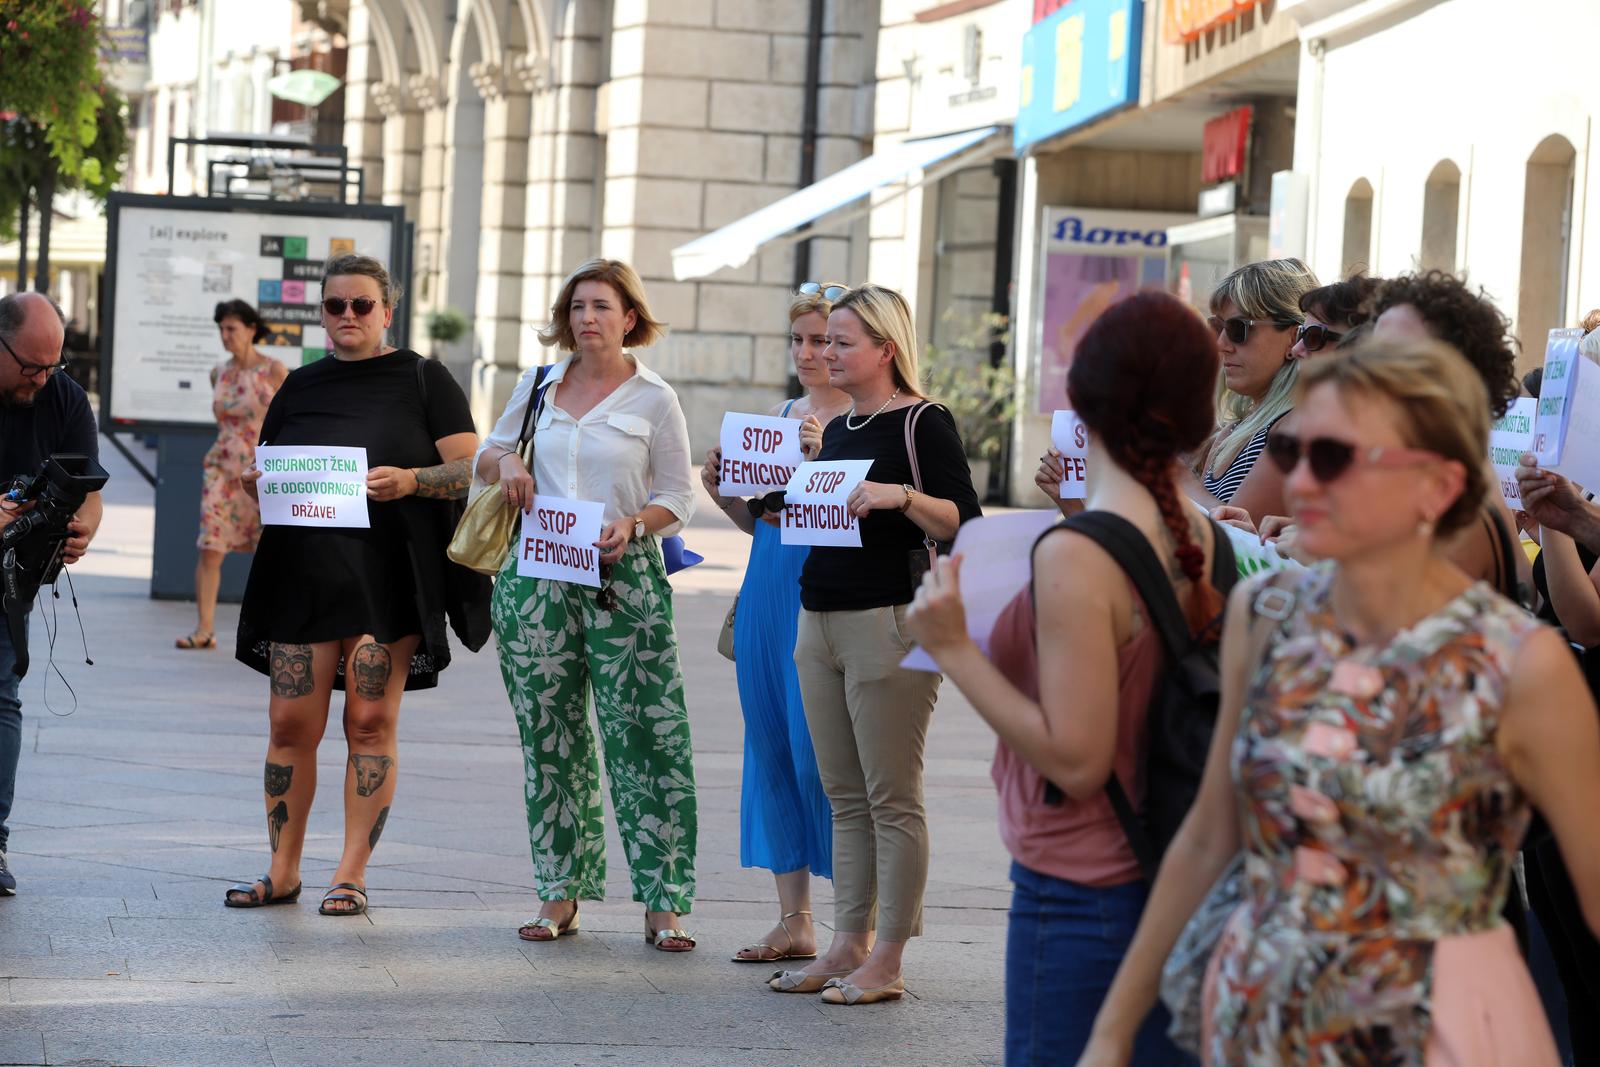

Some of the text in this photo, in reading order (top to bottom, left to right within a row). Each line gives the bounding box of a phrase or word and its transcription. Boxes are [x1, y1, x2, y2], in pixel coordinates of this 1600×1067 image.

[177, 229, 228, 241] explore
[742, 427, 783, 454] STOP
[264, 455, 358, 472] SIGURNOST ŽENA
[264, 481, 361, 497] JE ODGOVORNOST
[805, 471, 846, 494] STOP
[291, 501, 336, 519] DRŽAVE!
[538, 508, 577, 536] STOP
[523, 537, 595, 573] FEMICIDU!
